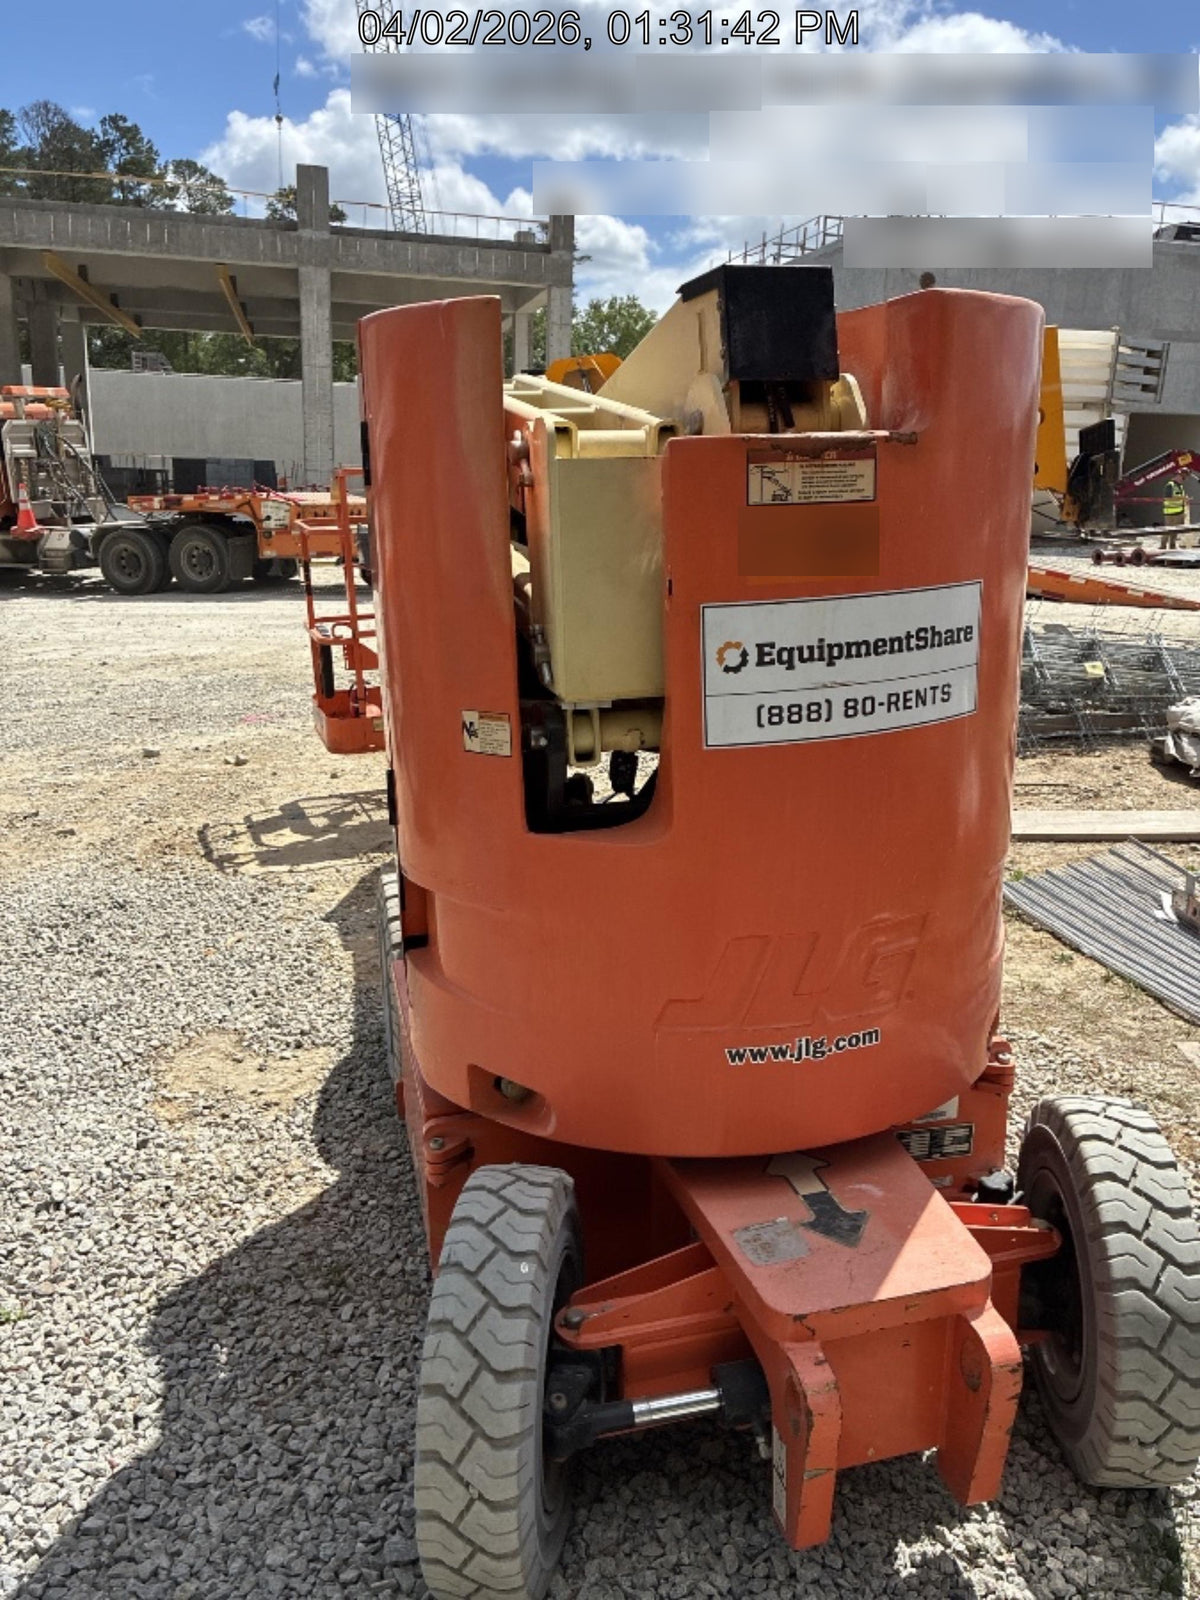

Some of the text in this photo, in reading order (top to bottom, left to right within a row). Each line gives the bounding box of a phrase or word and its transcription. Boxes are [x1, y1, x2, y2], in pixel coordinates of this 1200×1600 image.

[755, 624, 974, 671] EquipmentShare
[756, 683, 953, 729] (888) 80-RENTS
[653, 910, 932, 1031] JLG
[725, 1027, 881, 1065] www.jlg.com
